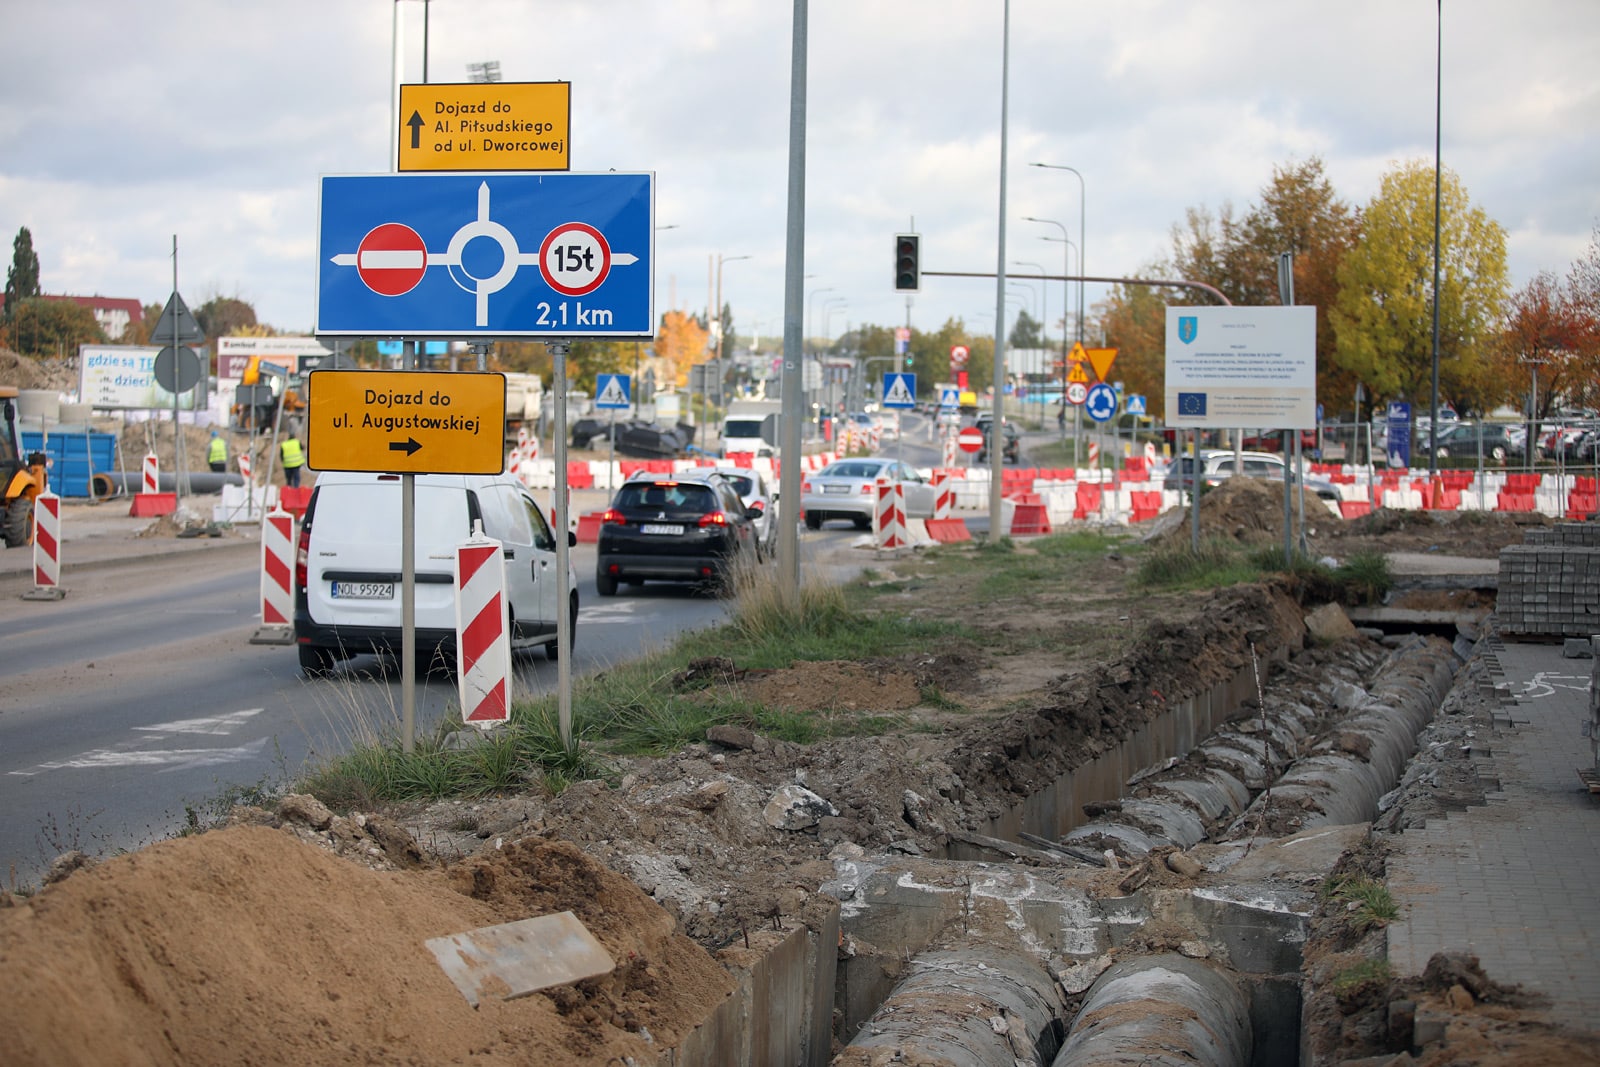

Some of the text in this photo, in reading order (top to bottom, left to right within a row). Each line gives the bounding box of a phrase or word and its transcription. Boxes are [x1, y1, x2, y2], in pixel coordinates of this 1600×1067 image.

[435, 100, 511, 117] Dojazd do
[435, 120, 553, 135] Al. Piłsudskiego
[434, 139, 564, 154] od ul. Dworcowej
[554, 246, 595, 272] 15t
[536, 302, 613, 328] 2,1 km
[88, 354, 119, 368] gdzie
[122, 355, 134, 368] są
[365, 390, 451, 408] Dojazd do
[1070, 387, 1086, 399] 40
[333, 413, 480, 435] ul. Augustowskiej
[338, 583, 392, 596] NOL 95924
